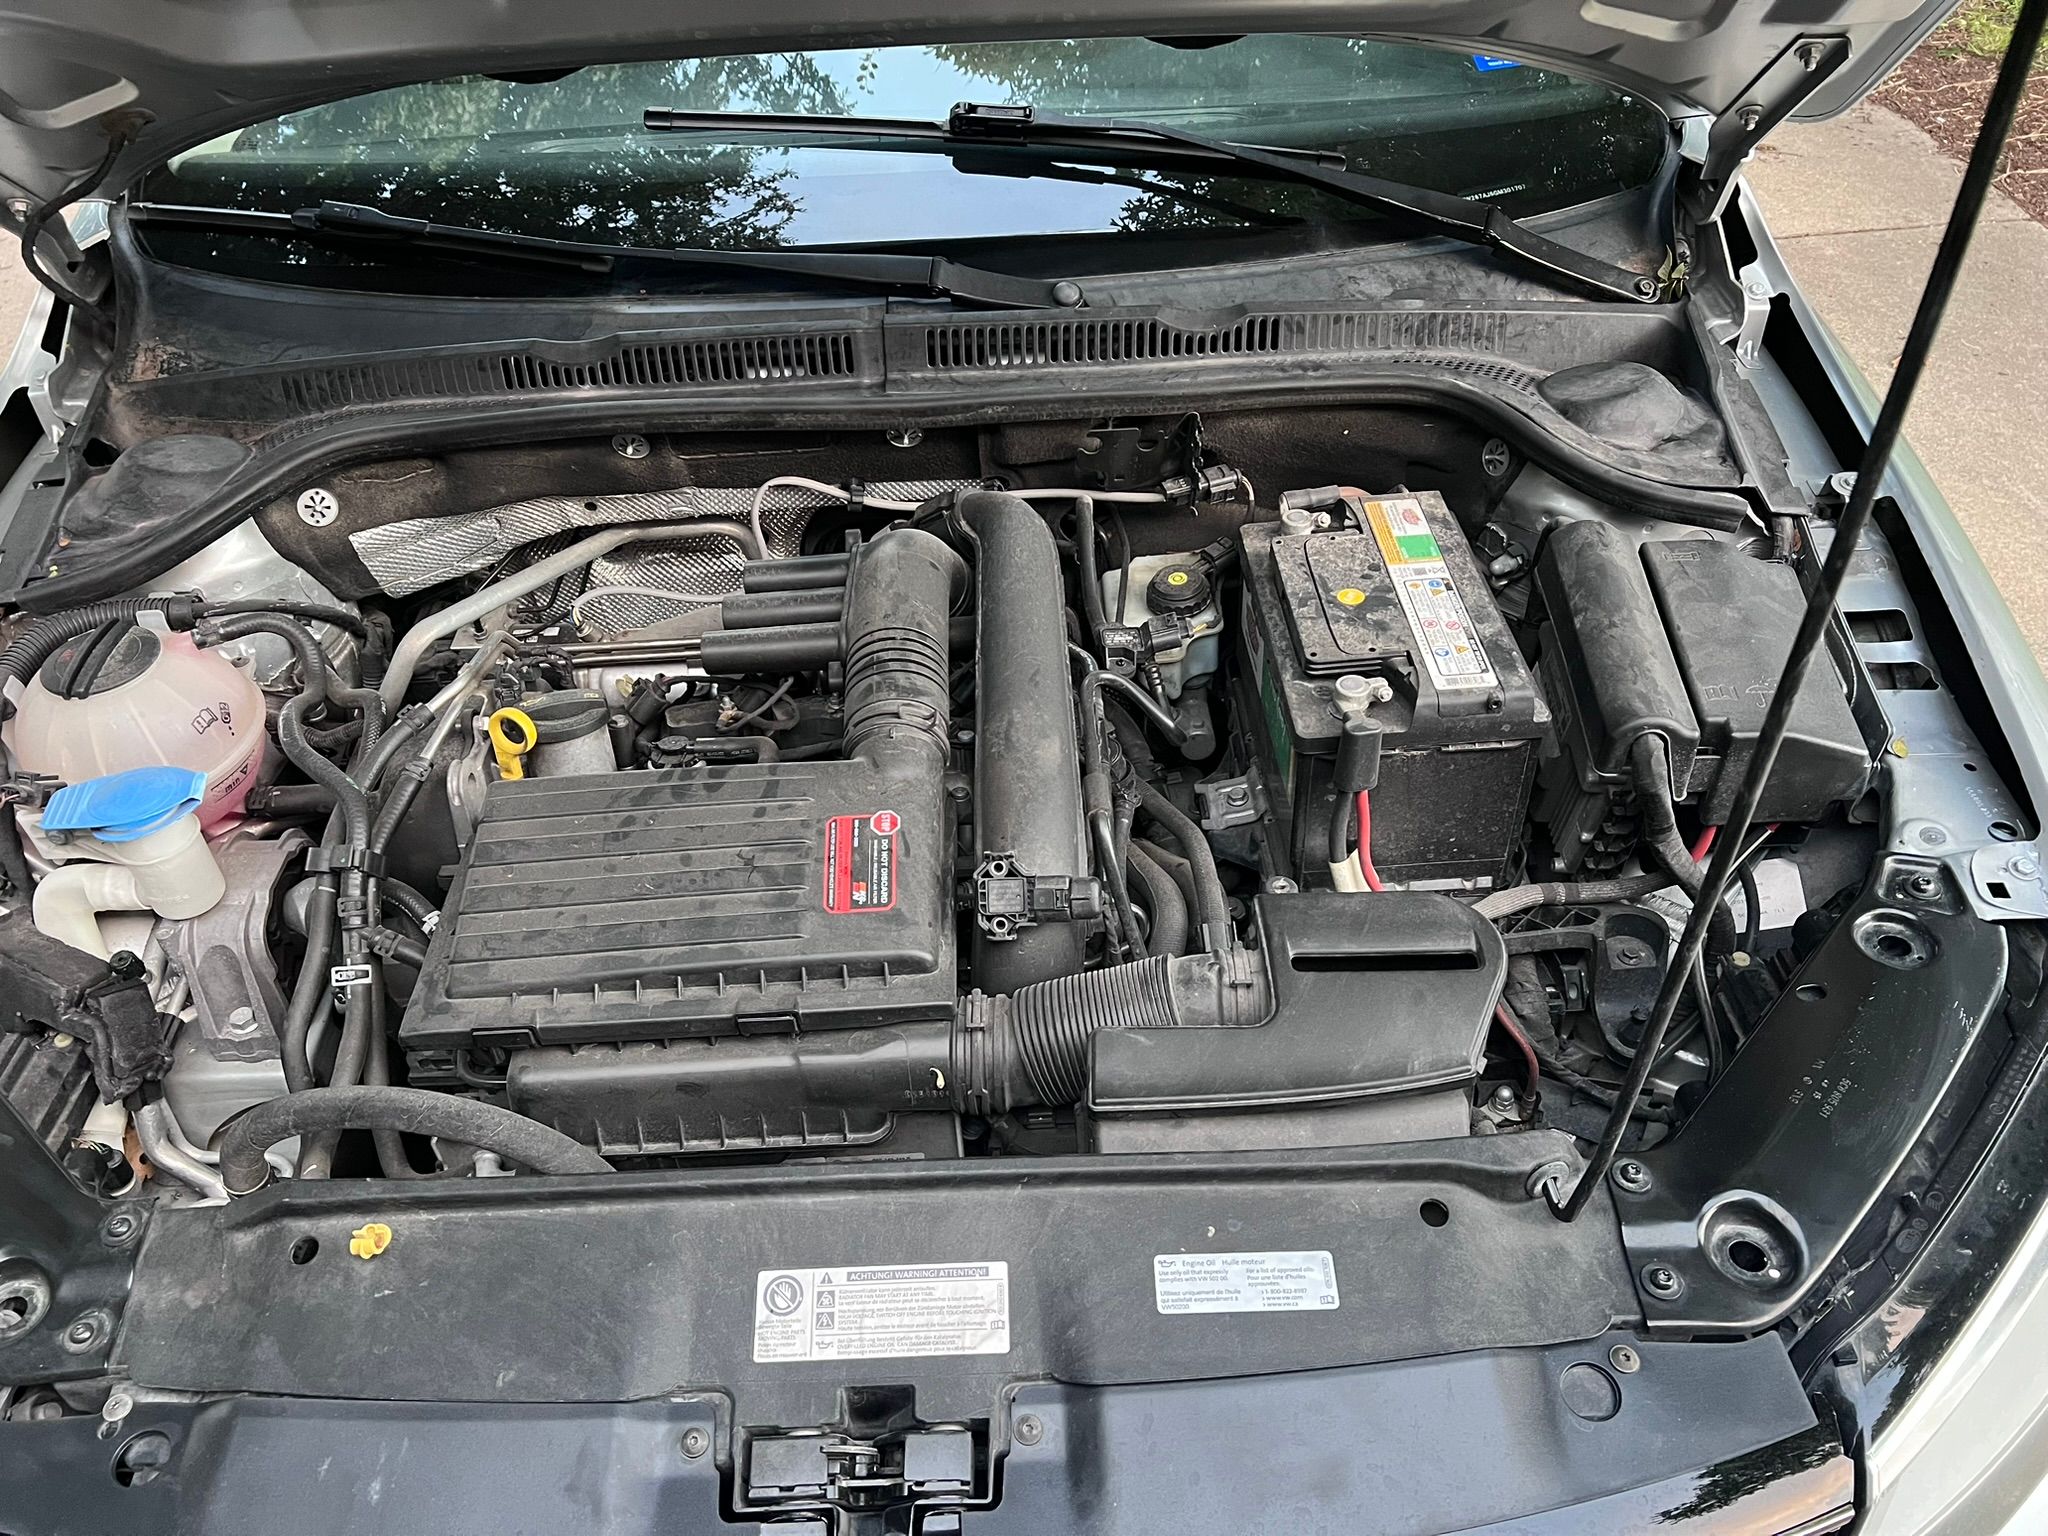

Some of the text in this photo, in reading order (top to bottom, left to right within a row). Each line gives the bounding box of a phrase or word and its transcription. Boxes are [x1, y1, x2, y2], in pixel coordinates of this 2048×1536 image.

[225, 777, 240, 793] min
[881, 814, 890, 831] STOP
[881, 839, 888, 850] DO
[880, 868, 888, 904] DISCARD
[850, 1267, 986, 1281] ACHTUNG! WARNING! ATTENTION!
